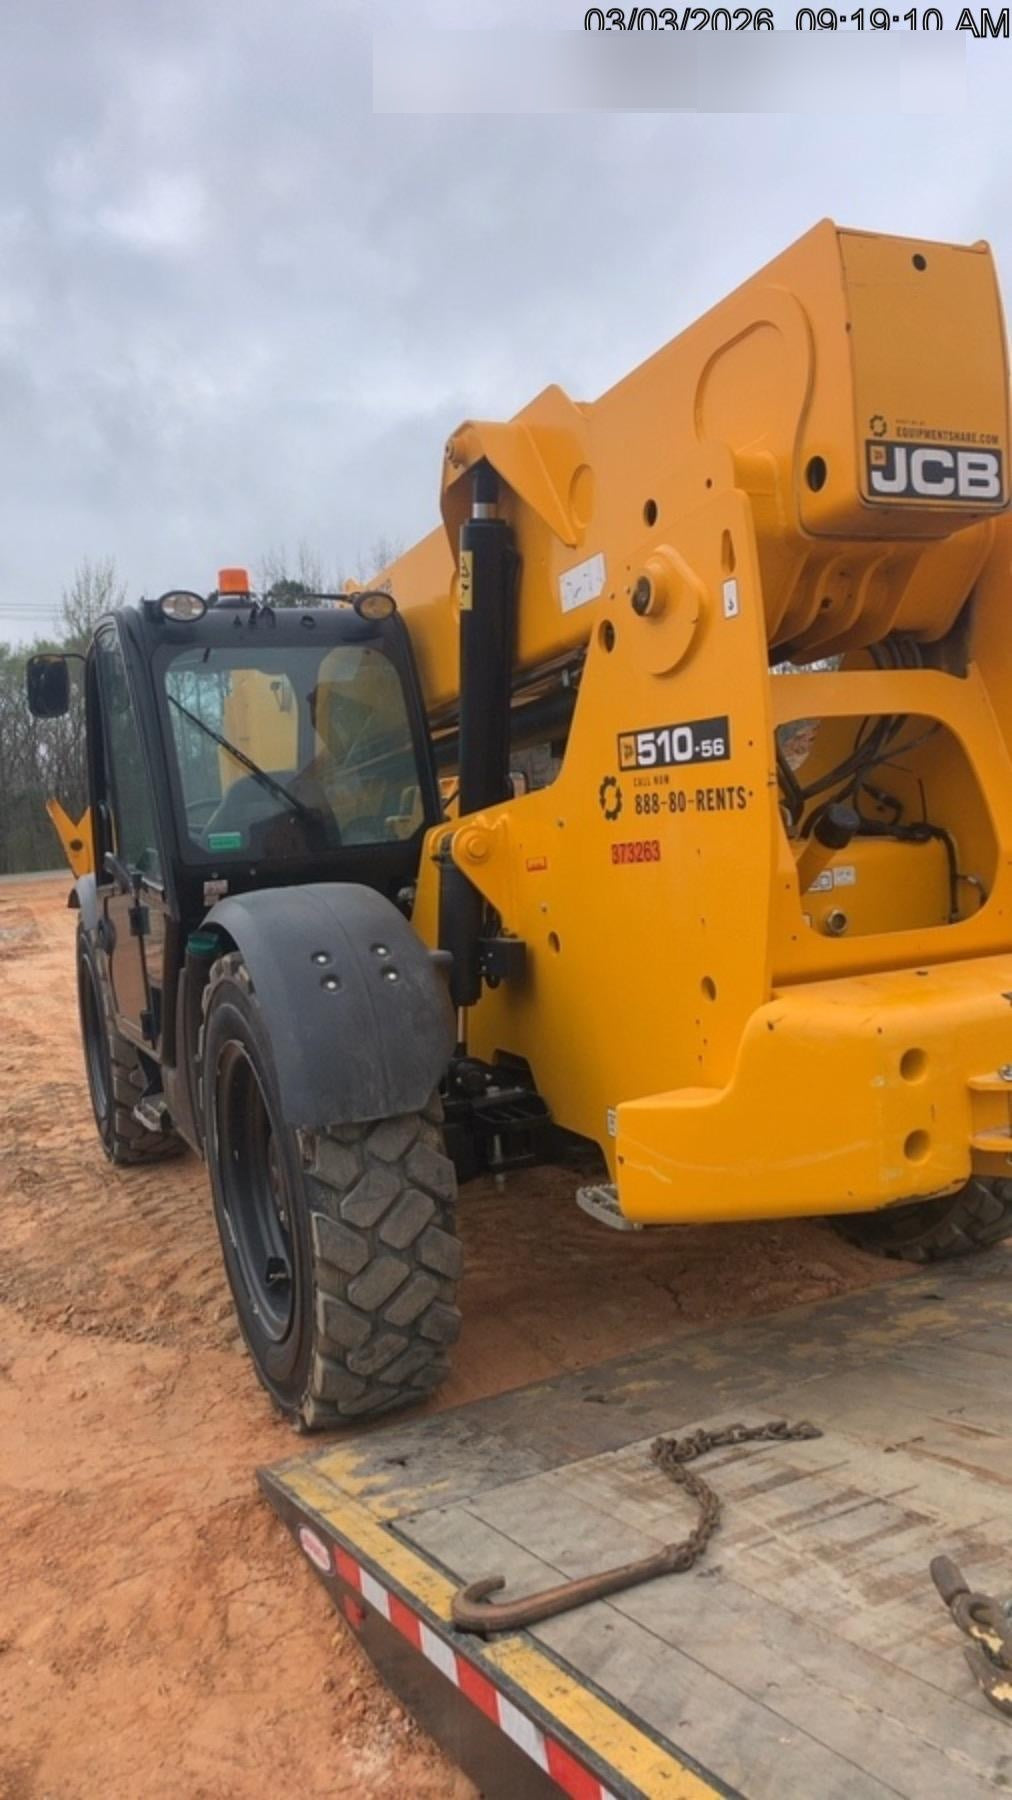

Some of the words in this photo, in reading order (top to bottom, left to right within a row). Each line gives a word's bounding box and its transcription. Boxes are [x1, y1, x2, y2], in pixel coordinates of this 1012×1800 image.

[896, 426, 999, 445] EQUIPMENTSHARE.COM
[871, 447, 1001, 498] JCB
[635, 786, 747, 815] 888-80-RENTS
[611, 840, 661, 865] 373263
